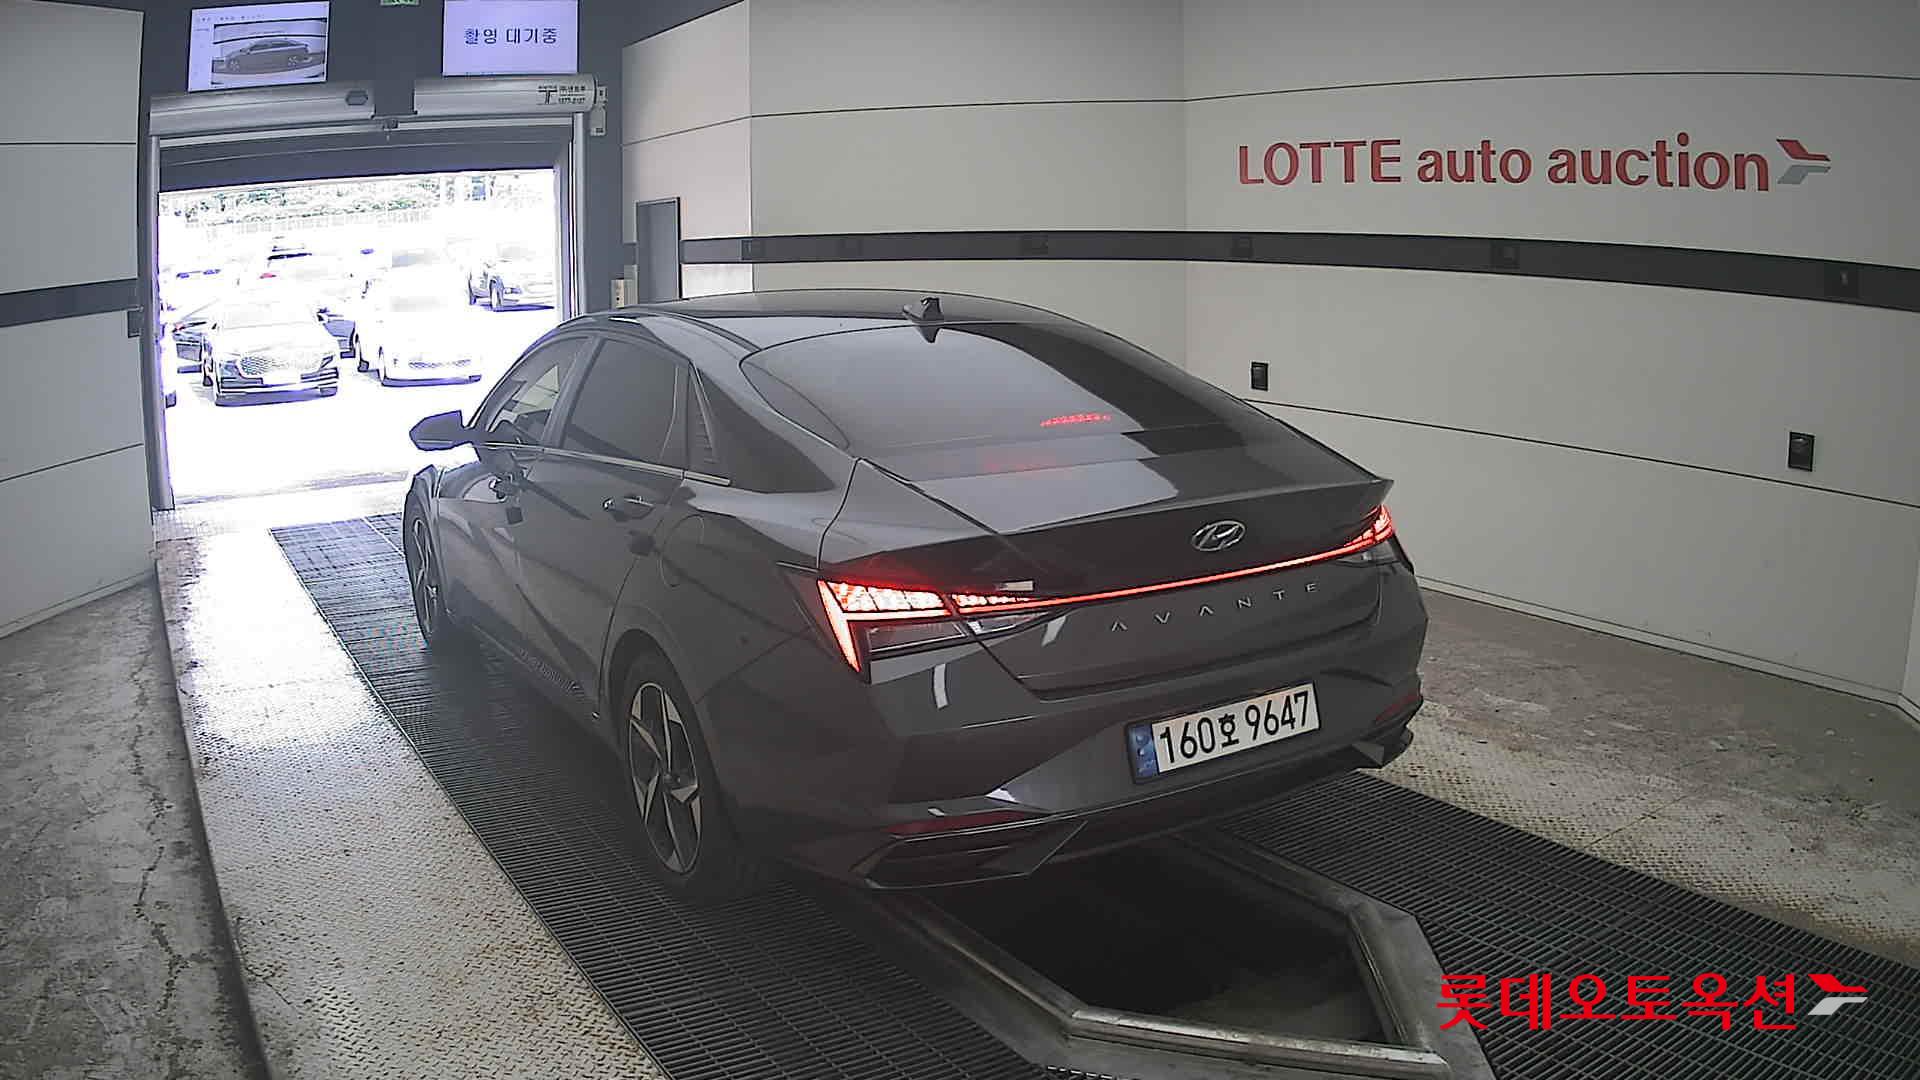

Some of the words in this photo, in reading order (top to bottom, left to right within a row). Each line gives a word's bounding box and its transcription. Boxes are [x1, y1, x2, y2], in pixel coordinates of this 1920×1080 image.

[506, 28, 557, 44] 대기중
[1239, 139, 1401, 185] LOTTE
[1417, 140, 1532, 183] auto
[1547, 132, 1769, 191] auction
[1111, 583, 1318, 632] AVANTE
[1159, 713, 1239, 764] 160호
[1244, 691, 1309, 742] 9647
